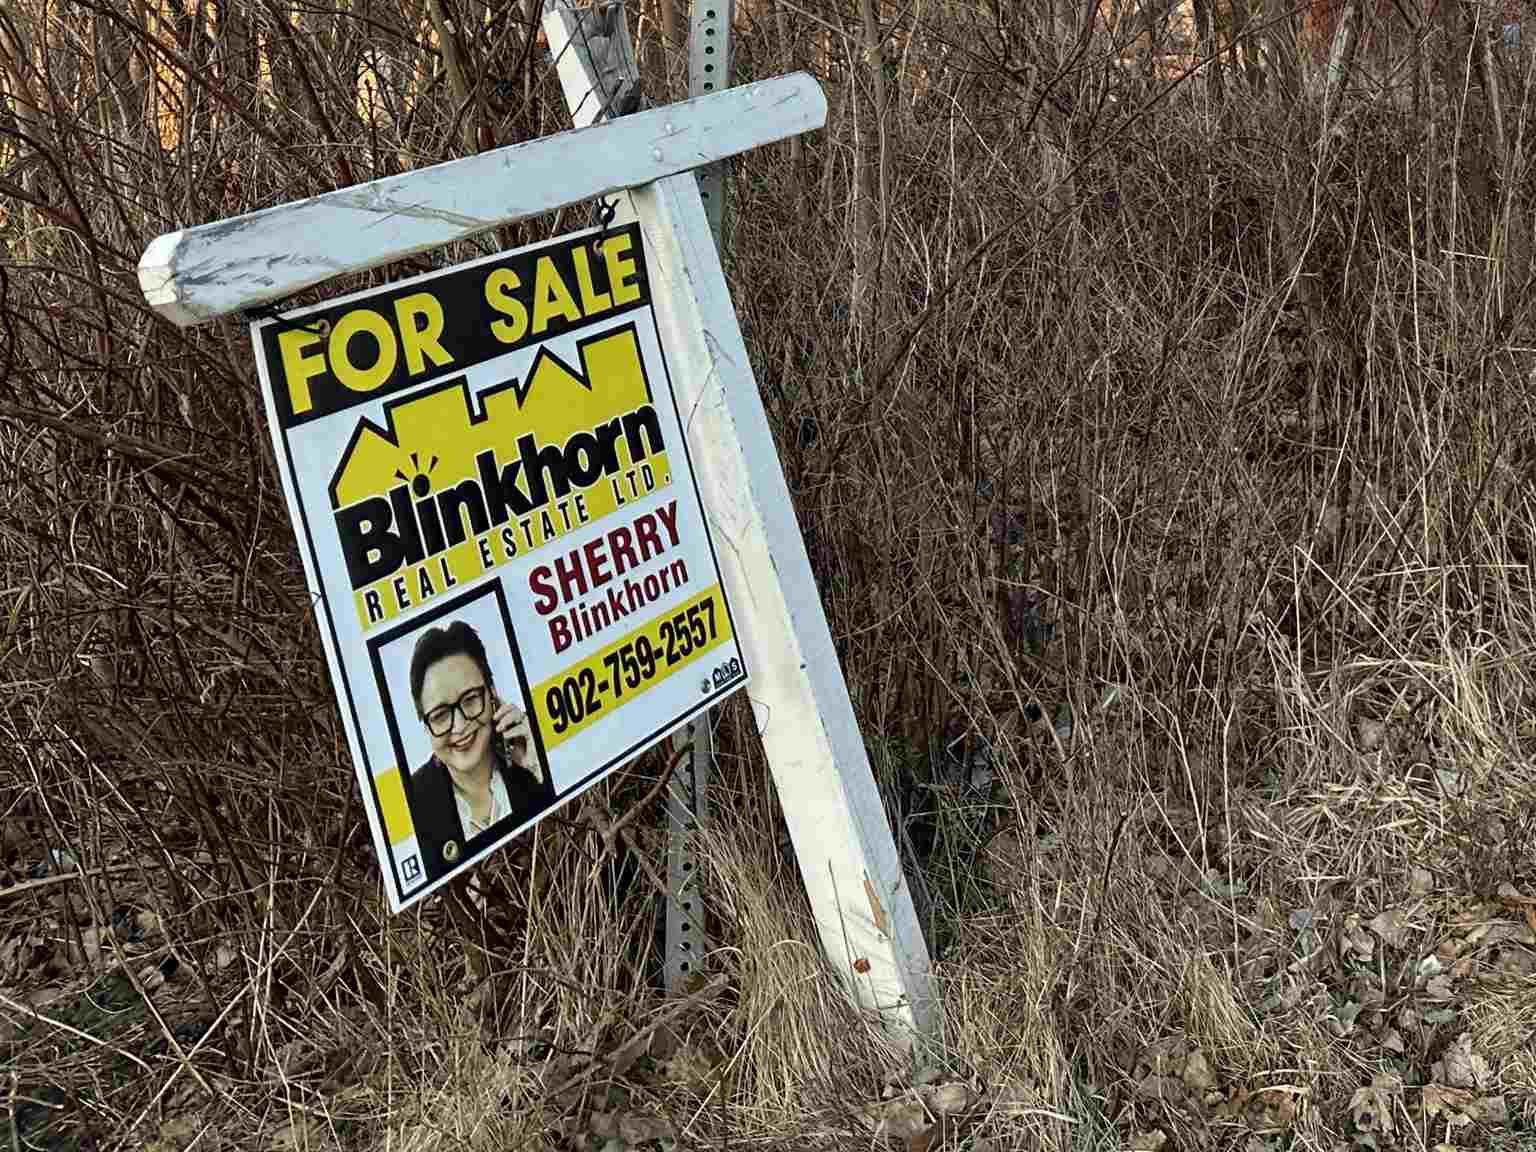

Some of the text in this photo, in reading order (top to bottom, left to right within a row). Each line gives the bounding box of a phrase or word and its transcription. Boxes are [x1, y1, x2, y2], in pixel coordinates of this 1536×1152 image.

[277, 233, 641, 415] FOR SALE
[333, 403, 665, 590] Blinkhorn
[363, 460, 672, 623] REAL ESTATE LTD.
[529, 500, 681, 616] SHERRY
[545, 598, 719, 734] 902-759-2557
[548, 557, 689, 655] Blinkhorn
